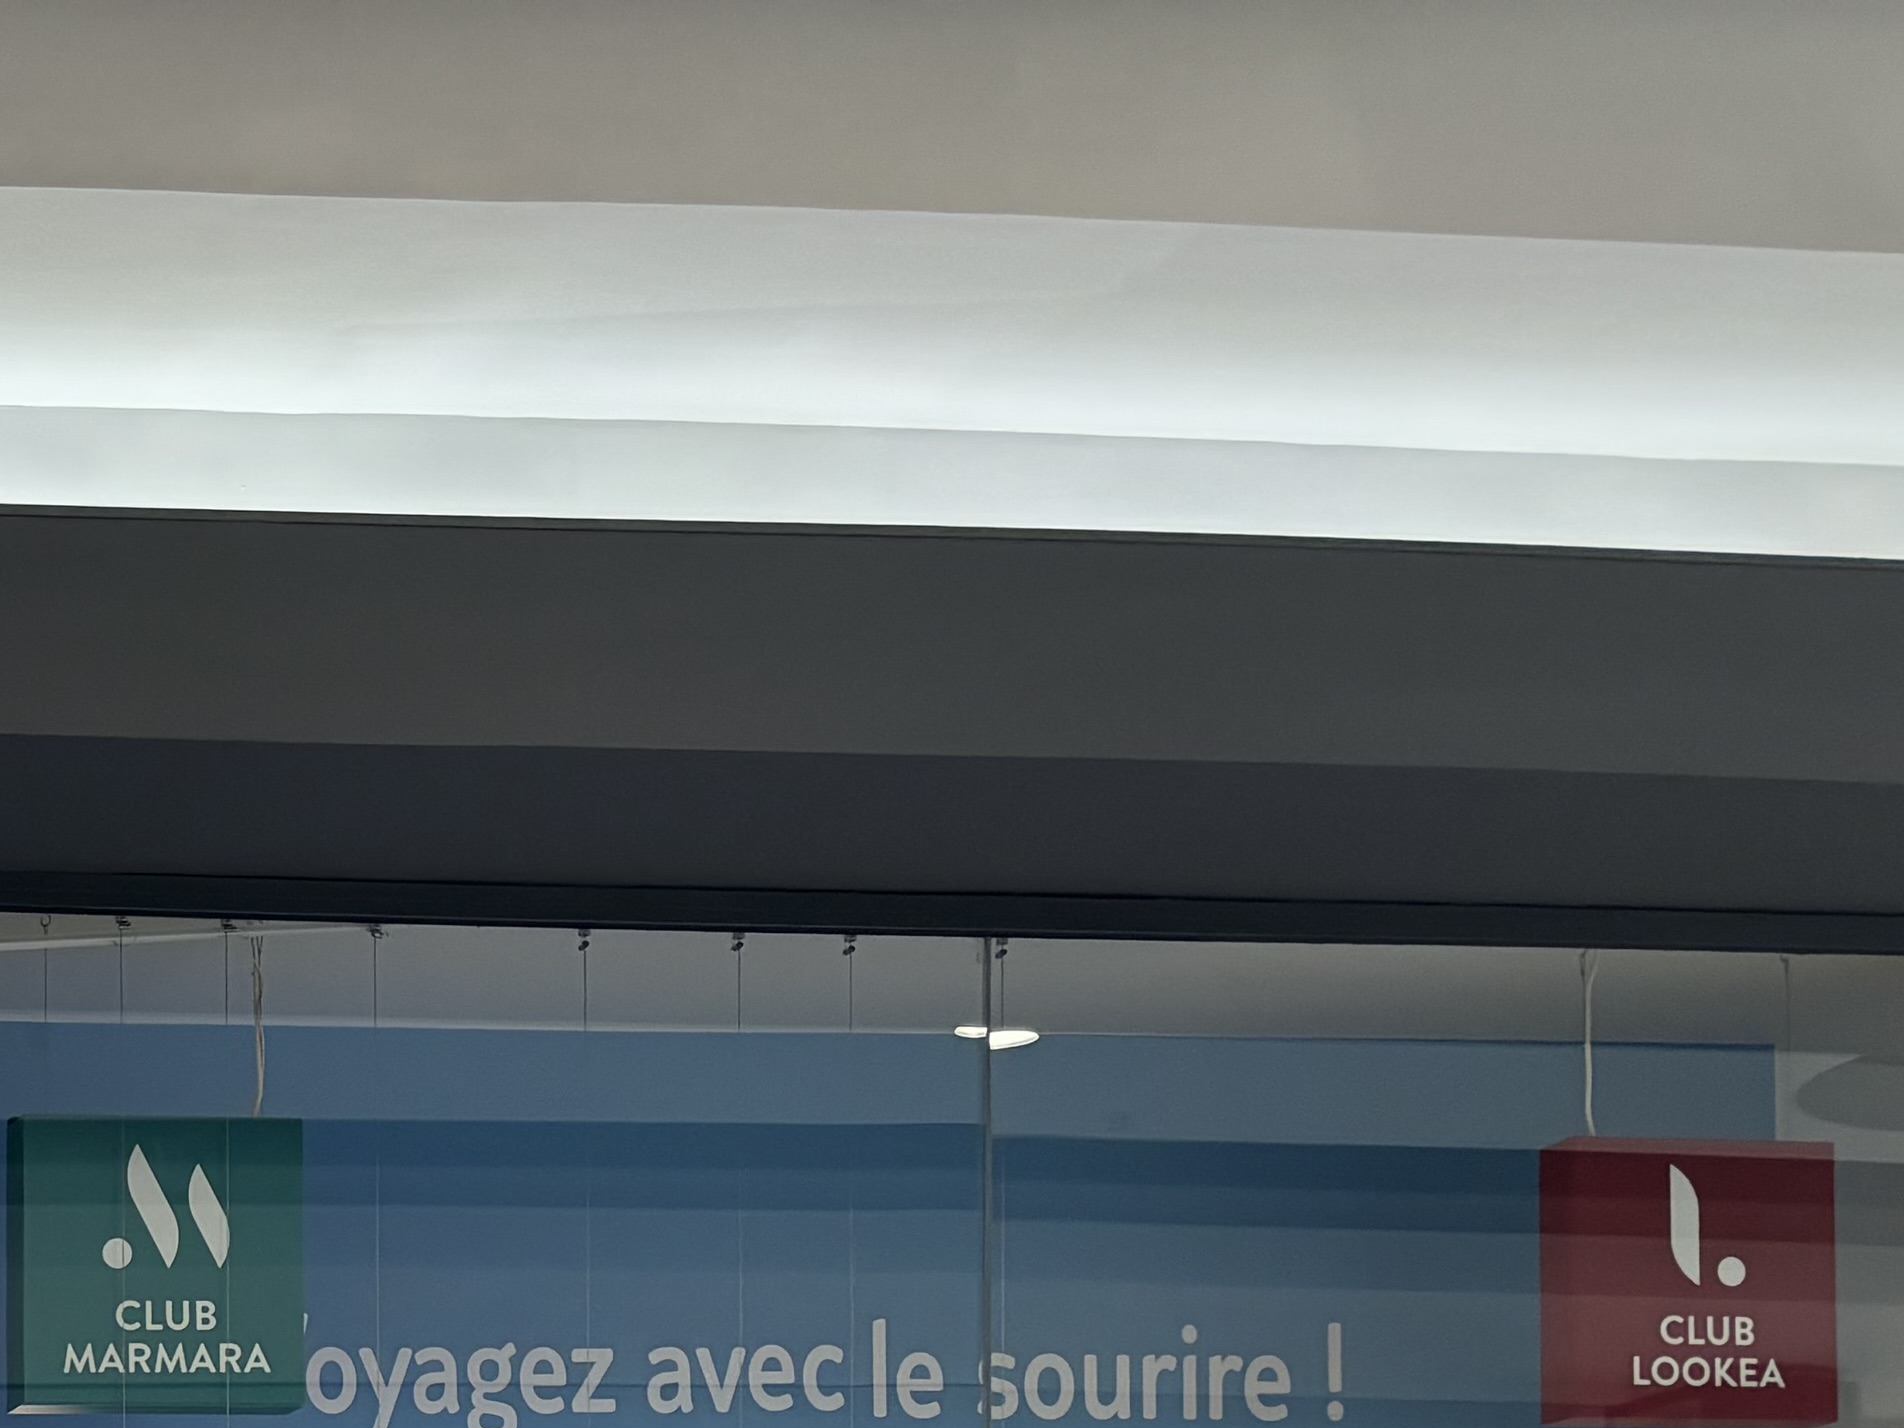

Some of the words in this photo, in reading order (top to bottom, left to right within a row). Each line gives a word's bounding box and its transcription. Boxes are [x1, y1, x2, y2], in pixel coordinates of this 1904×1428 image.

[114, 1299, 218, 1332] CLUB
[1660, 1315, 1755, 1346] CLUB
[62, 1341, 272, 1375] MARMARA
[647, 1333, 845, 1418] avec
[871, 1317, 944, 1418] le
[976, 1321, 1291, 1423] sourire
[1633, 1356, 1785, 1388] LOOKEA
